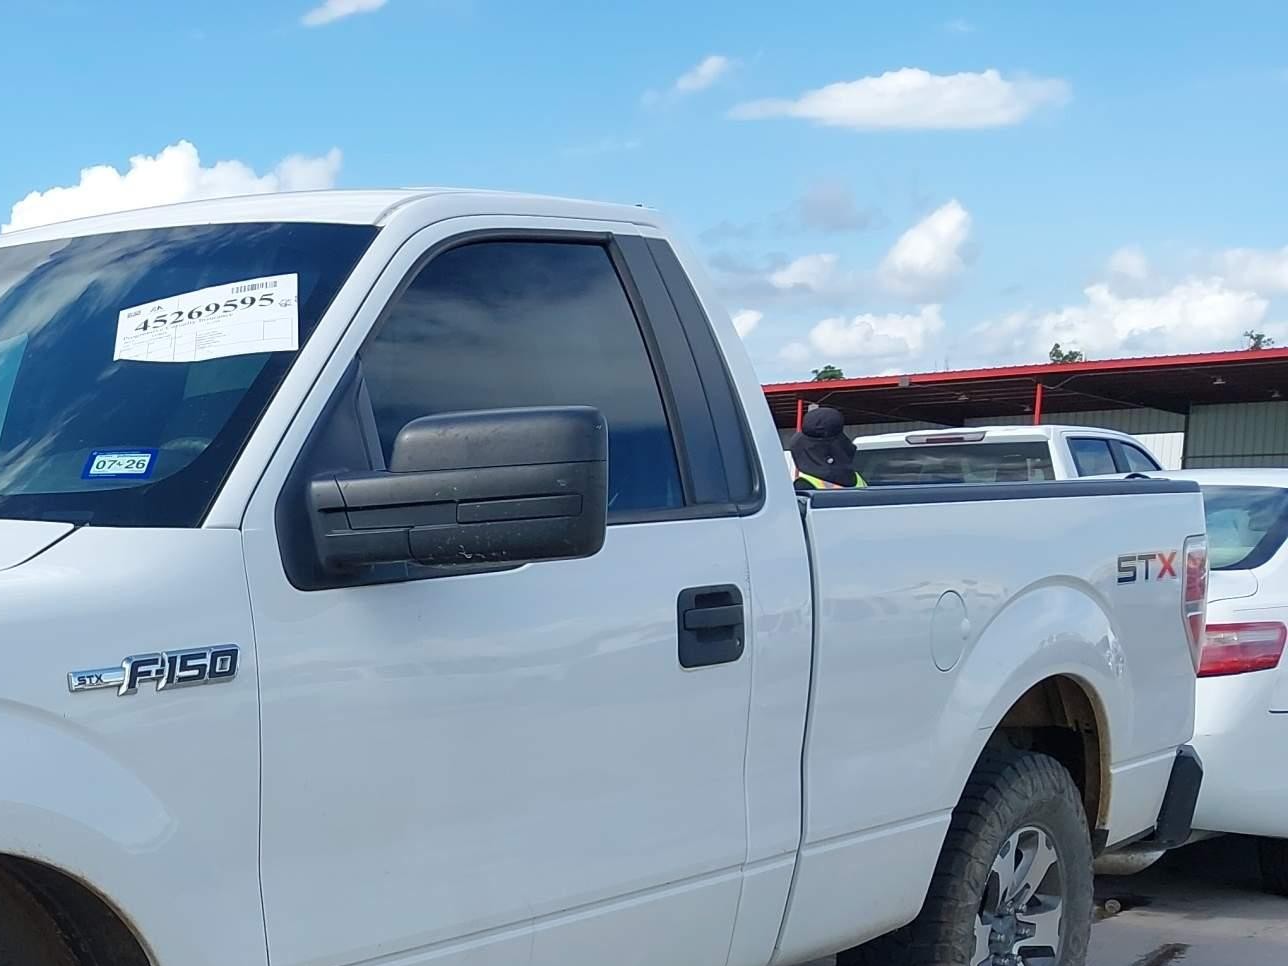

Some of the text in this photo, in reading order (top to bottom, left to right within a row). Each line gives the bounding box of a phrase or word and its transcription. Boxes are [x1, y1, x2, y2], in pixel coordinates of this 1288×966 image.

[134, 293, 275, 332] 45269595
[1117, 551, 1177, 583] STX
[77, 644, 240, 696] STX F-150
